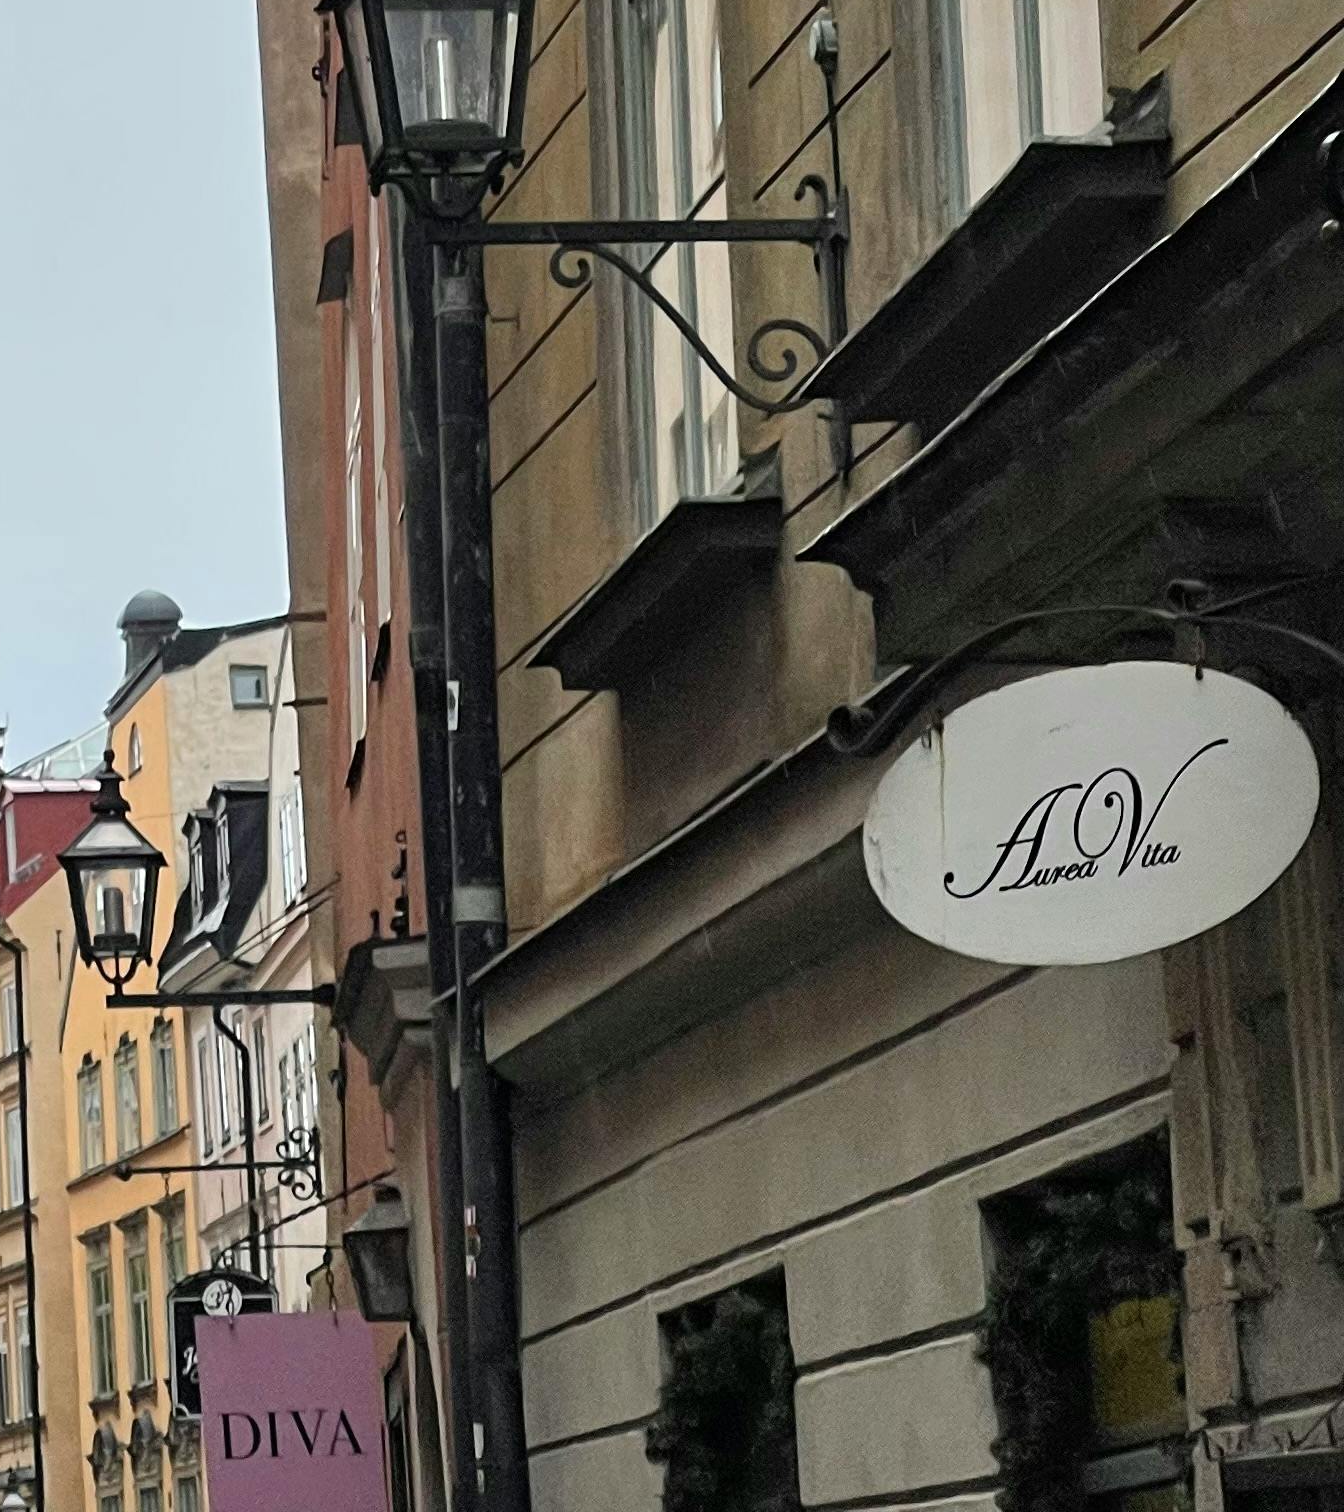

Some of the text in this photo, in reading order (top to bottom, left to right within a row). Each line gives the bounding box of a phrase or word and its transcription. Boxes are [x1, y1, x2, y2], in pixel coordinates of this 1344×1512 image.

[944, 738, 1229, 899] Aurea Vita
[218, 1408, 367, 1461] DIVA
